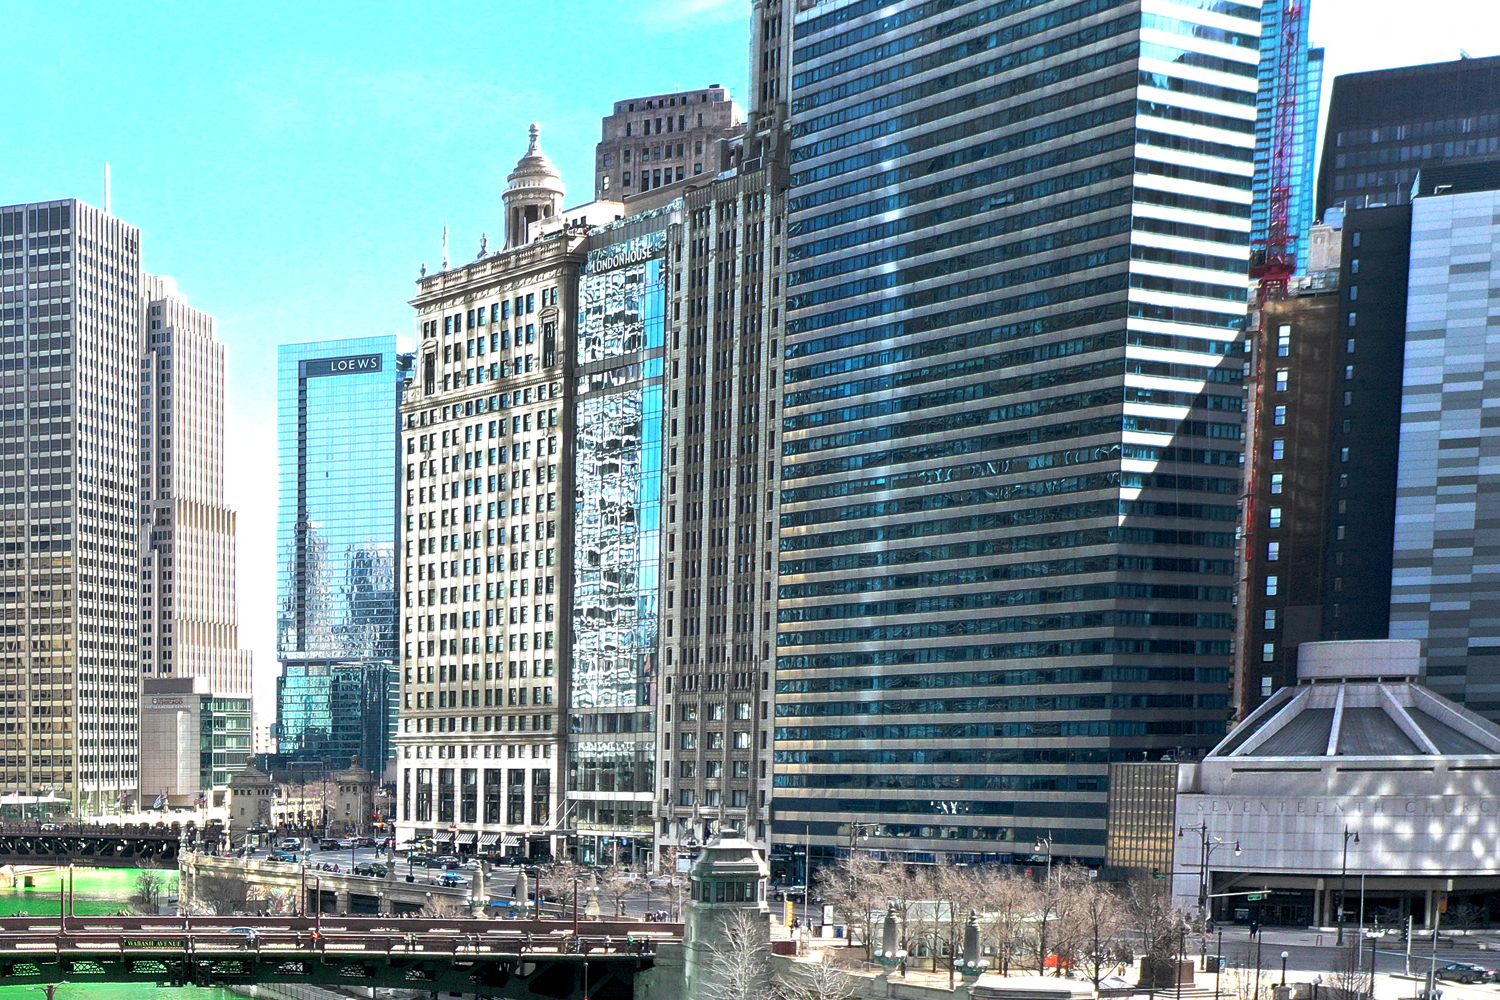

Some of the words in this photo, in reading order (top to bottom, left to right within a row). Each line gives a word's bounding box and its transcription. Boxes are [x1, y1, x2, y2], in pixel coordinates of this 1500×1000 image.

[331, 358, 377, 371] LOEWS
[1197, 800, 1385, 813] SEVENTEENTH
[1405, 800, 1500, 813] CHURC
